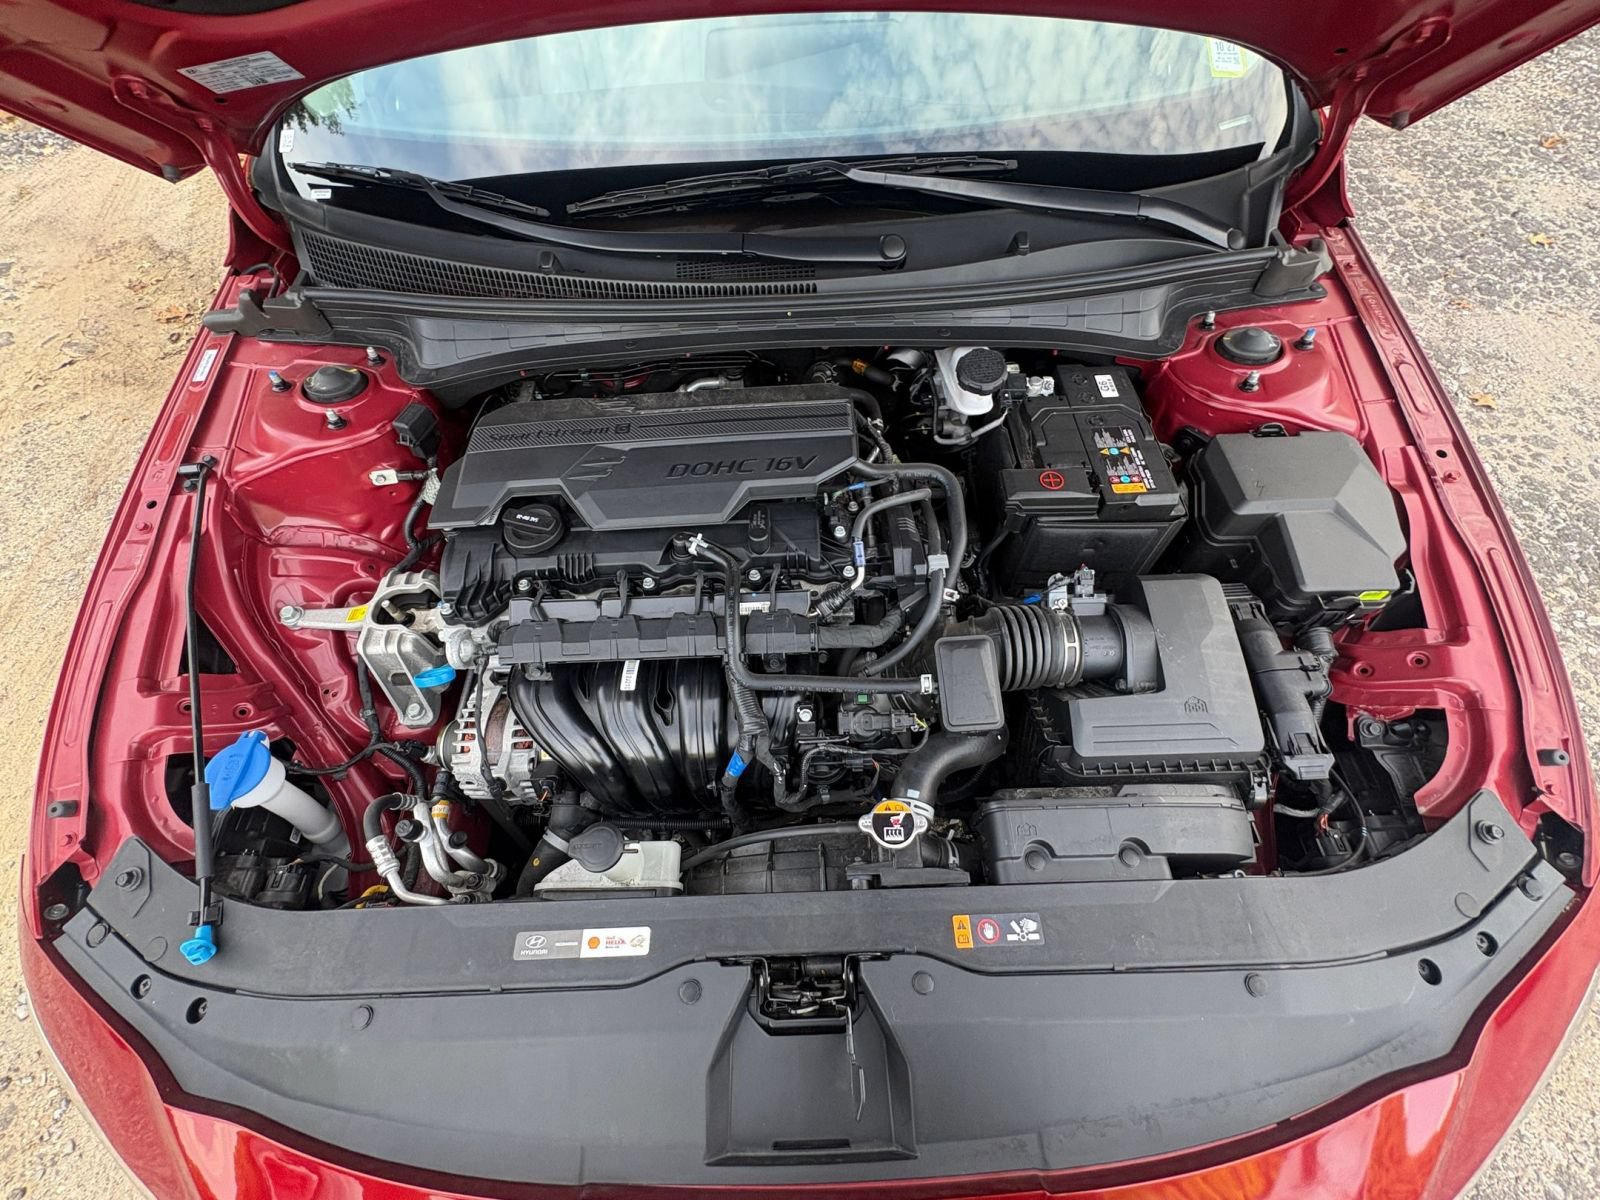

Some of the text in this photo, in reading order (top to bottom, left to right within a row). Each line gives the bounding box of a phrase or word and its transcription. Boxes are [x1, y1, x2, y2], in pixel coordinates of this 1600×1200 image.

[1098, 380, 1110, 391] G6
[488, 426, 610, 442] Smartstream
[664, 454, 819, 479] DOHC 16V
[520, 948, 549, 956] HYUNDAI
